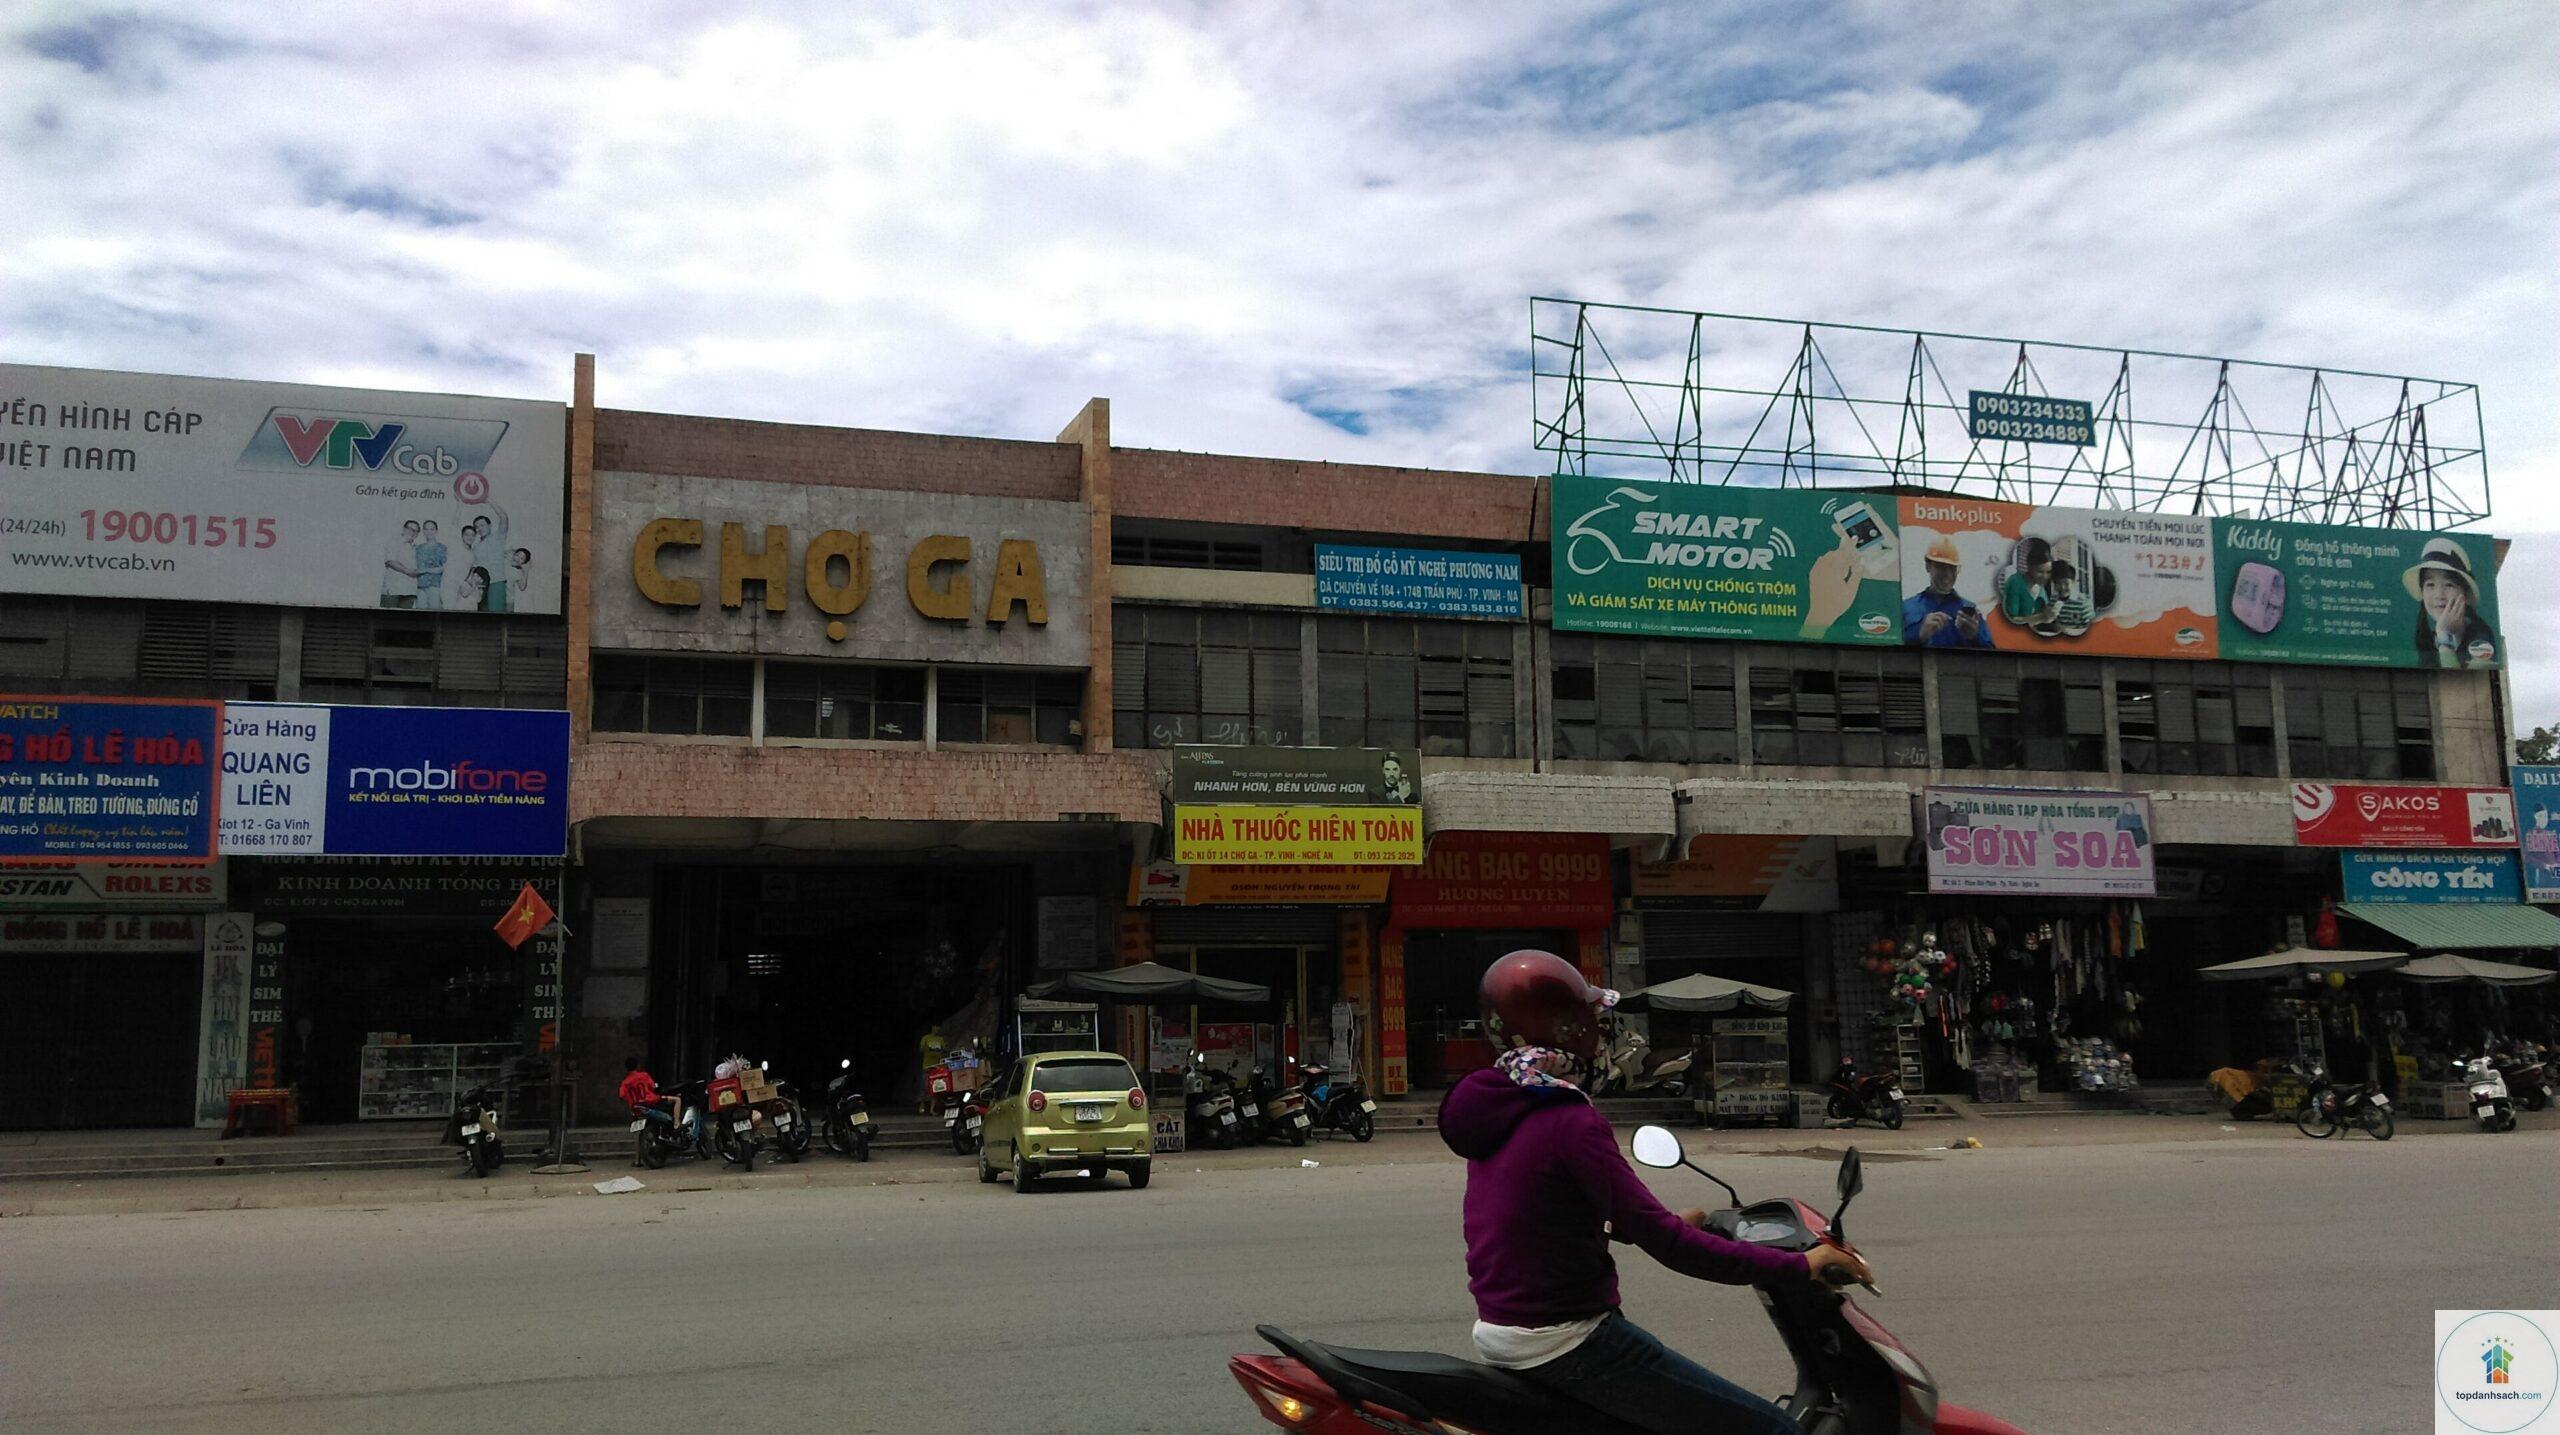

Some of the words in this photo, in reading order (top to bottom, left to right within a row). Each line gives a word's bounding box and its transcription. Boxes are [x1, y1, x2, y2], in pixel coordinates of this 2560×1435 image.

[60, 400, 131, 431] HÌNH
[144, 406, 203, 435] CÁP
[1976, 396, 2086, 421] 0903234333
[1976, 418, 2089, 442] 0903234889
[64, 446, 136, 472] NAM
[0, 518, 66, 536] (24/24h)
[81, 510, 277, 549] 19001515
[1631, 511, 1763, 540] SMART
[2226, 525, 2283, 561] Kiddy
[12, 553, 176, 572] www.vtvcab.vn
[1646, 542, 1775, 571] MOTOR
[634, 518, 870, 642] CHỢ
[907, 534, 1048, 625] GA
[1495, 564, 1519, 581] NAM
[1568, 592, 1587, 607] VÀ
[1657, 598, 1674, 611] XE
[1709, 599, 1758, 615] THÔNG
[1760, 603, 1797, 616] MINH
[266, 720, 316, 741] Hàng
[83, 728, 125, 764] LÊ
[222, 751, 311, 774] QUANG
[40, 773, 89, 786] Kinh
[96, 773, 160, 788] Doanh
[349, 760, 548, 792] mobifone
[1193, 781, 1239, 792] NHANH
[237, 780, 291, 806] LIÊN
[2362, 795, 2440, 811] SAKOS
[242, 819, 254, 830] 12
[265, 819, 280, 830] Ga
[284, 819, 310, 830] Vinh
[1182, 812, 1225, 841] NHÀ
[1232, 811, 1301, 842] THUỐC
[1362, 814, 1414, 842] TOÀN
[232, 834, 266, 846] 01668
[270, 835, 289, 845] 170
[292, 835, 313, 845] 807
[1942, 824, 2038, 868] SƠN
[2053, 829, 2142, 869] SOA
[1538, 852, 1601, 882] 9999
[2371, 866, 2441, 889] CÔNG
[0, 879, 73, 896] STAN
[105, 875, 212, 893] ROLEXS
[279, 877, 341, 890] KINH
[350, 877, 431, 890] DOANH
[256, 941, 284, 957] ĐẠI
[253, 986, 282, 1001] SIM
